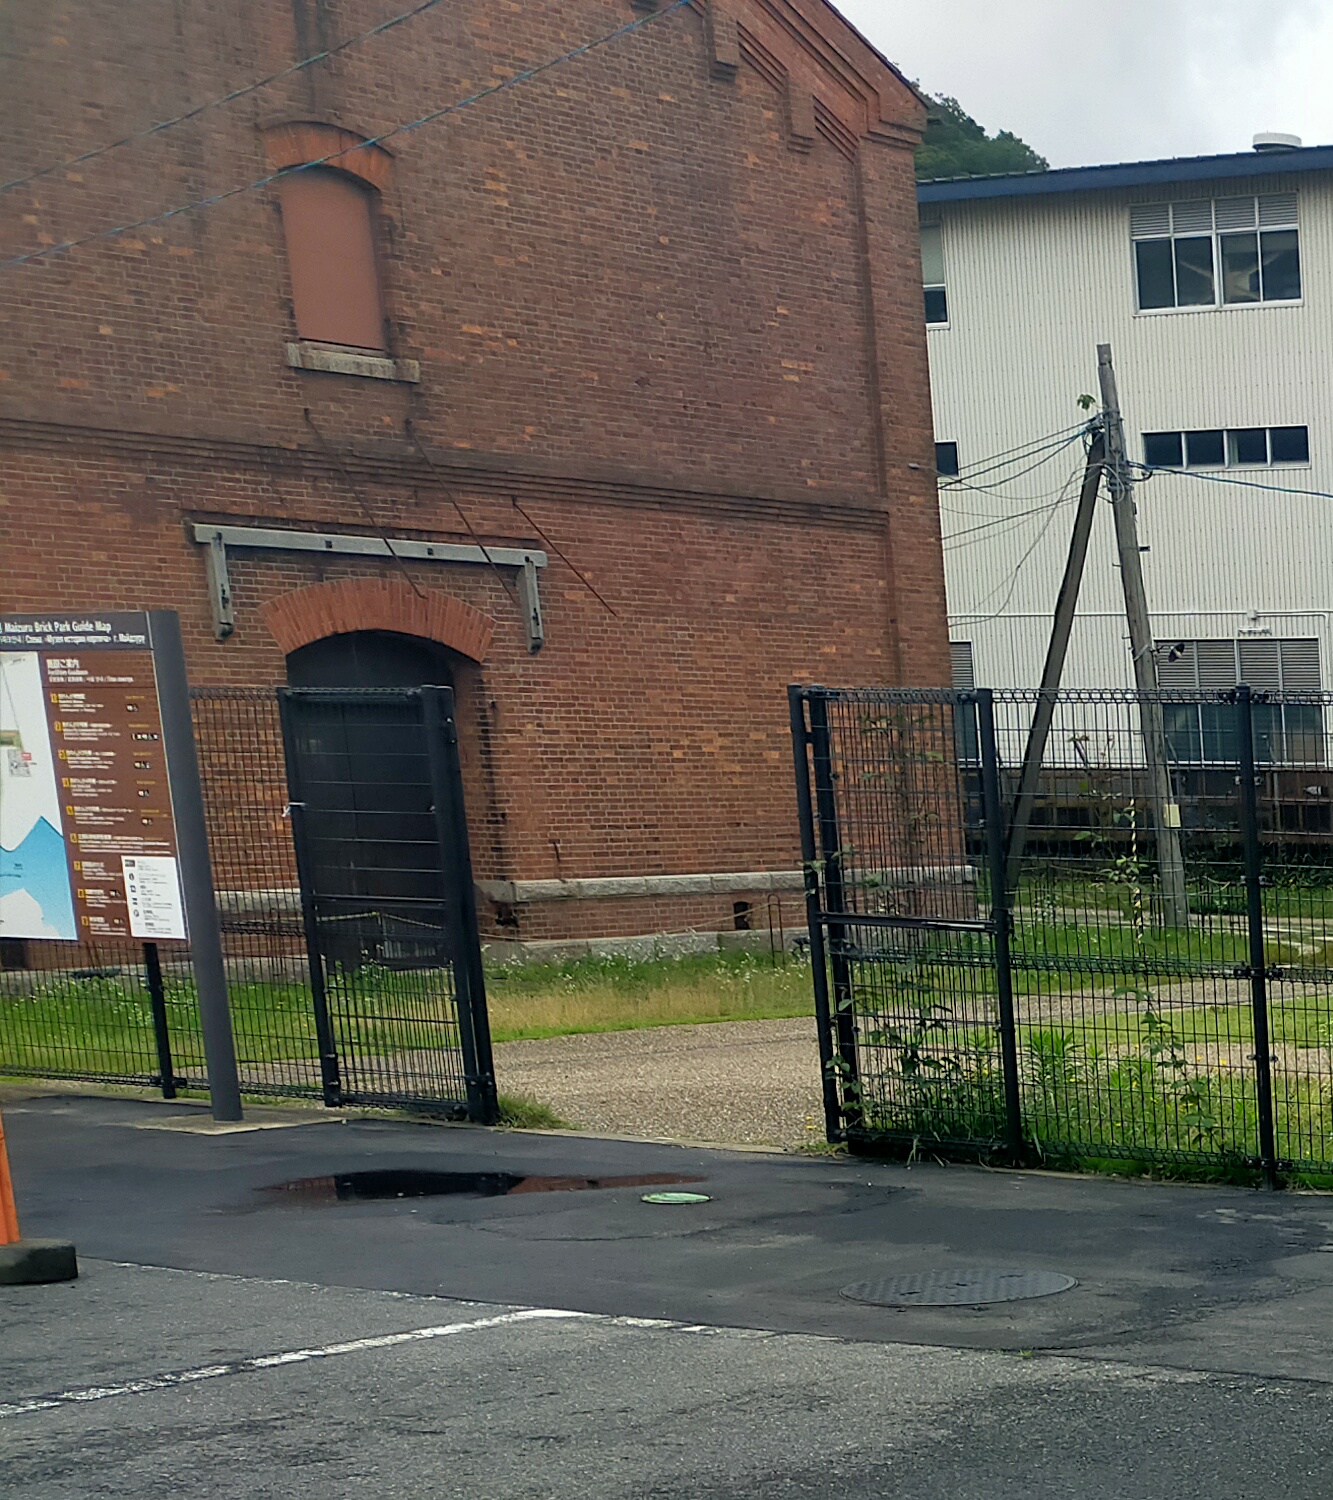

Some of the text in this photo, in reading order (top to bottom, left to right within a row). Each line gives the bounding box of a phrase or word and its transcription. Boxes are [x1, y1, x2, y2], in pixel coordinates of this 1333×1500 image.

[34, 621, 53, 632] Brick
[54, 620, 71, 632] Park
[72, 620, 94, 632] Guide
[95, 621, 112, 633] Map
